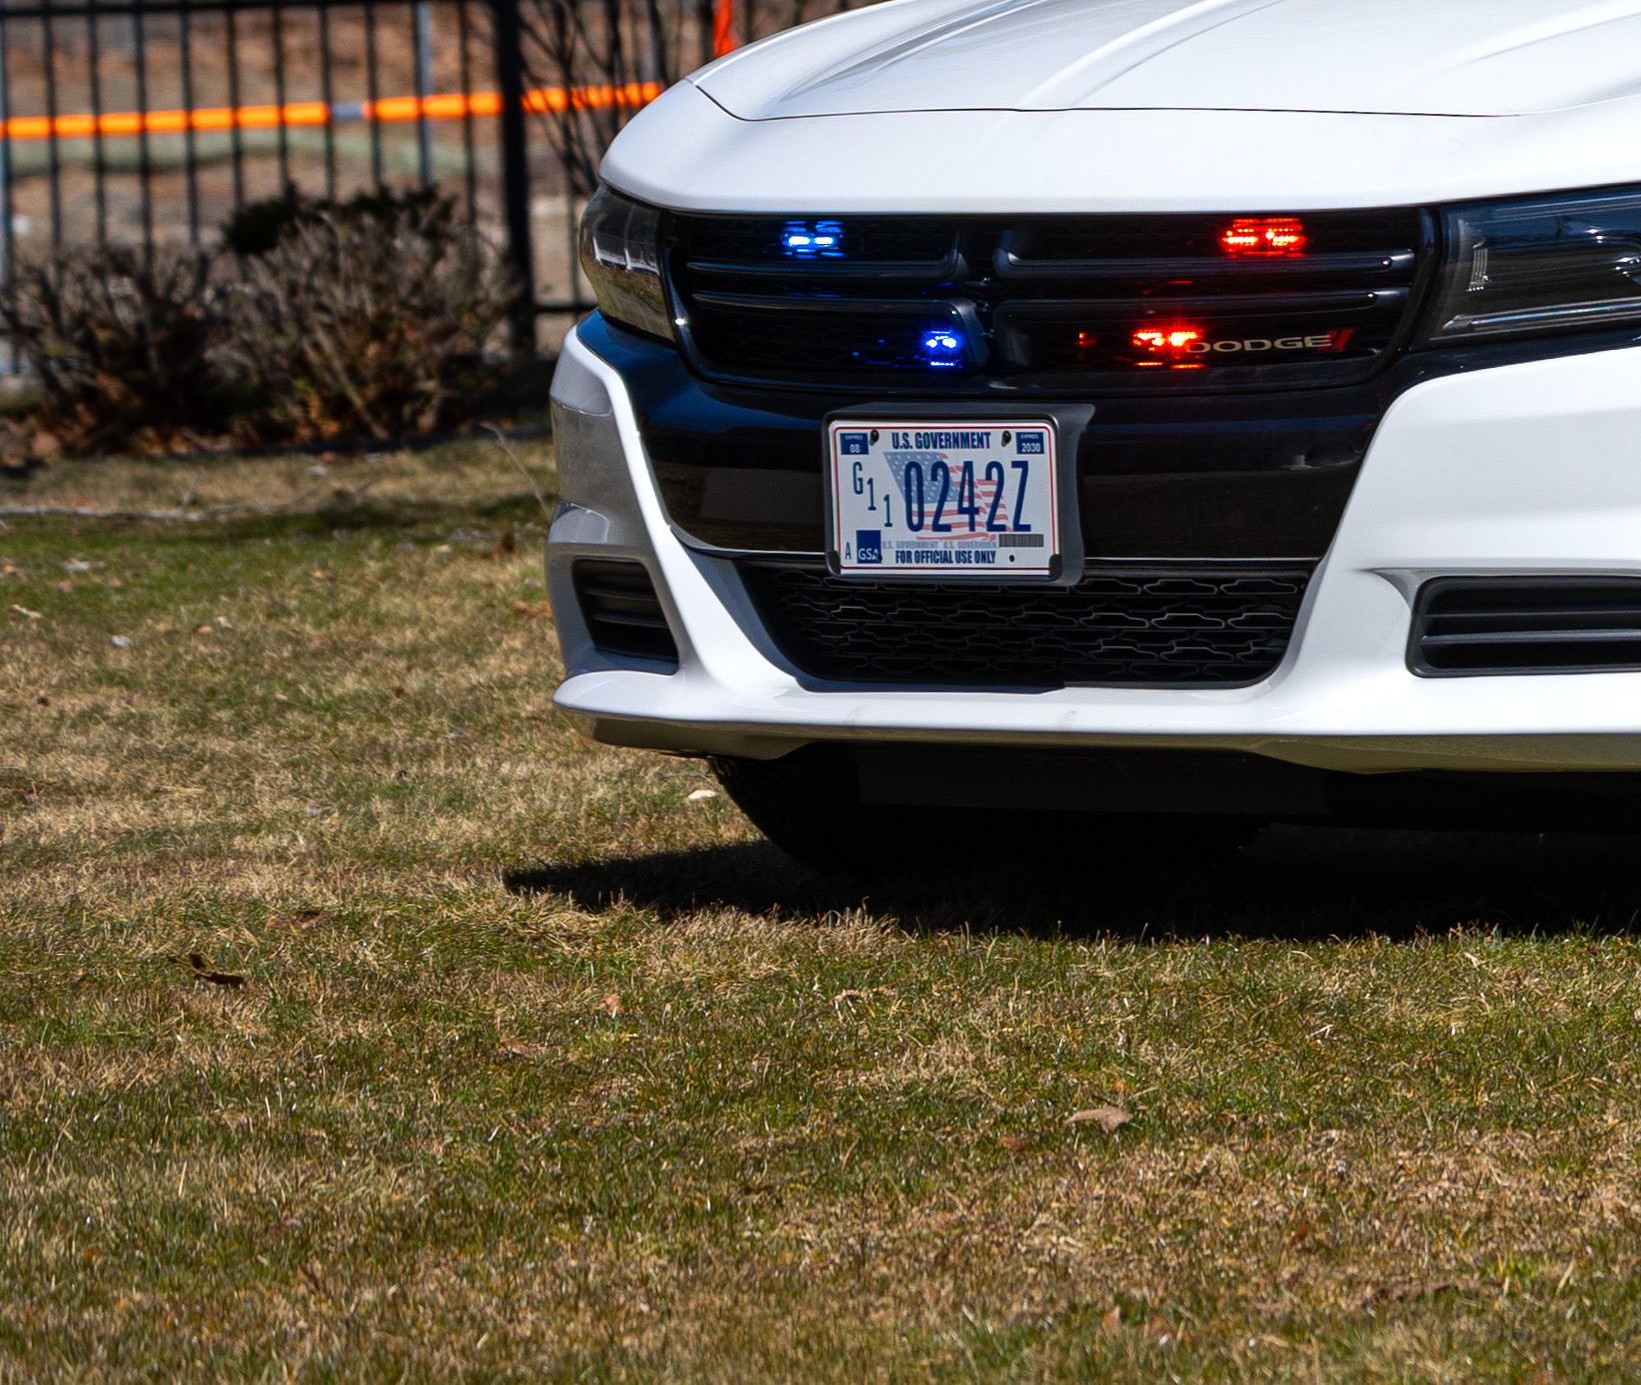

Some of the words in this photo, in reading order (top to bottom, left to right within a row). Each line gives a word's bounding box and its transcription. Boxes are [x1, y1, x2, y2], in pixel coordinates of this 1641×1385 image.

[1185, 334, 1332, 354] DODGE
[891, 431, 913, 450] U.S.
[915, 431, 992, 449] GOVERNMENT
[1021, 442, 1041, 453] 2030
[904, 460, 1032, 533] 0242Z
[844, 541, 852, 560] A
[858, 547, 881, 561] GSA
[895, 550, 912, 564] FOR
[914, 550, 953, 564] OFFICIAL
[955, 550, 972, 564] USE
[974, 550, 997, 564] ONLY
